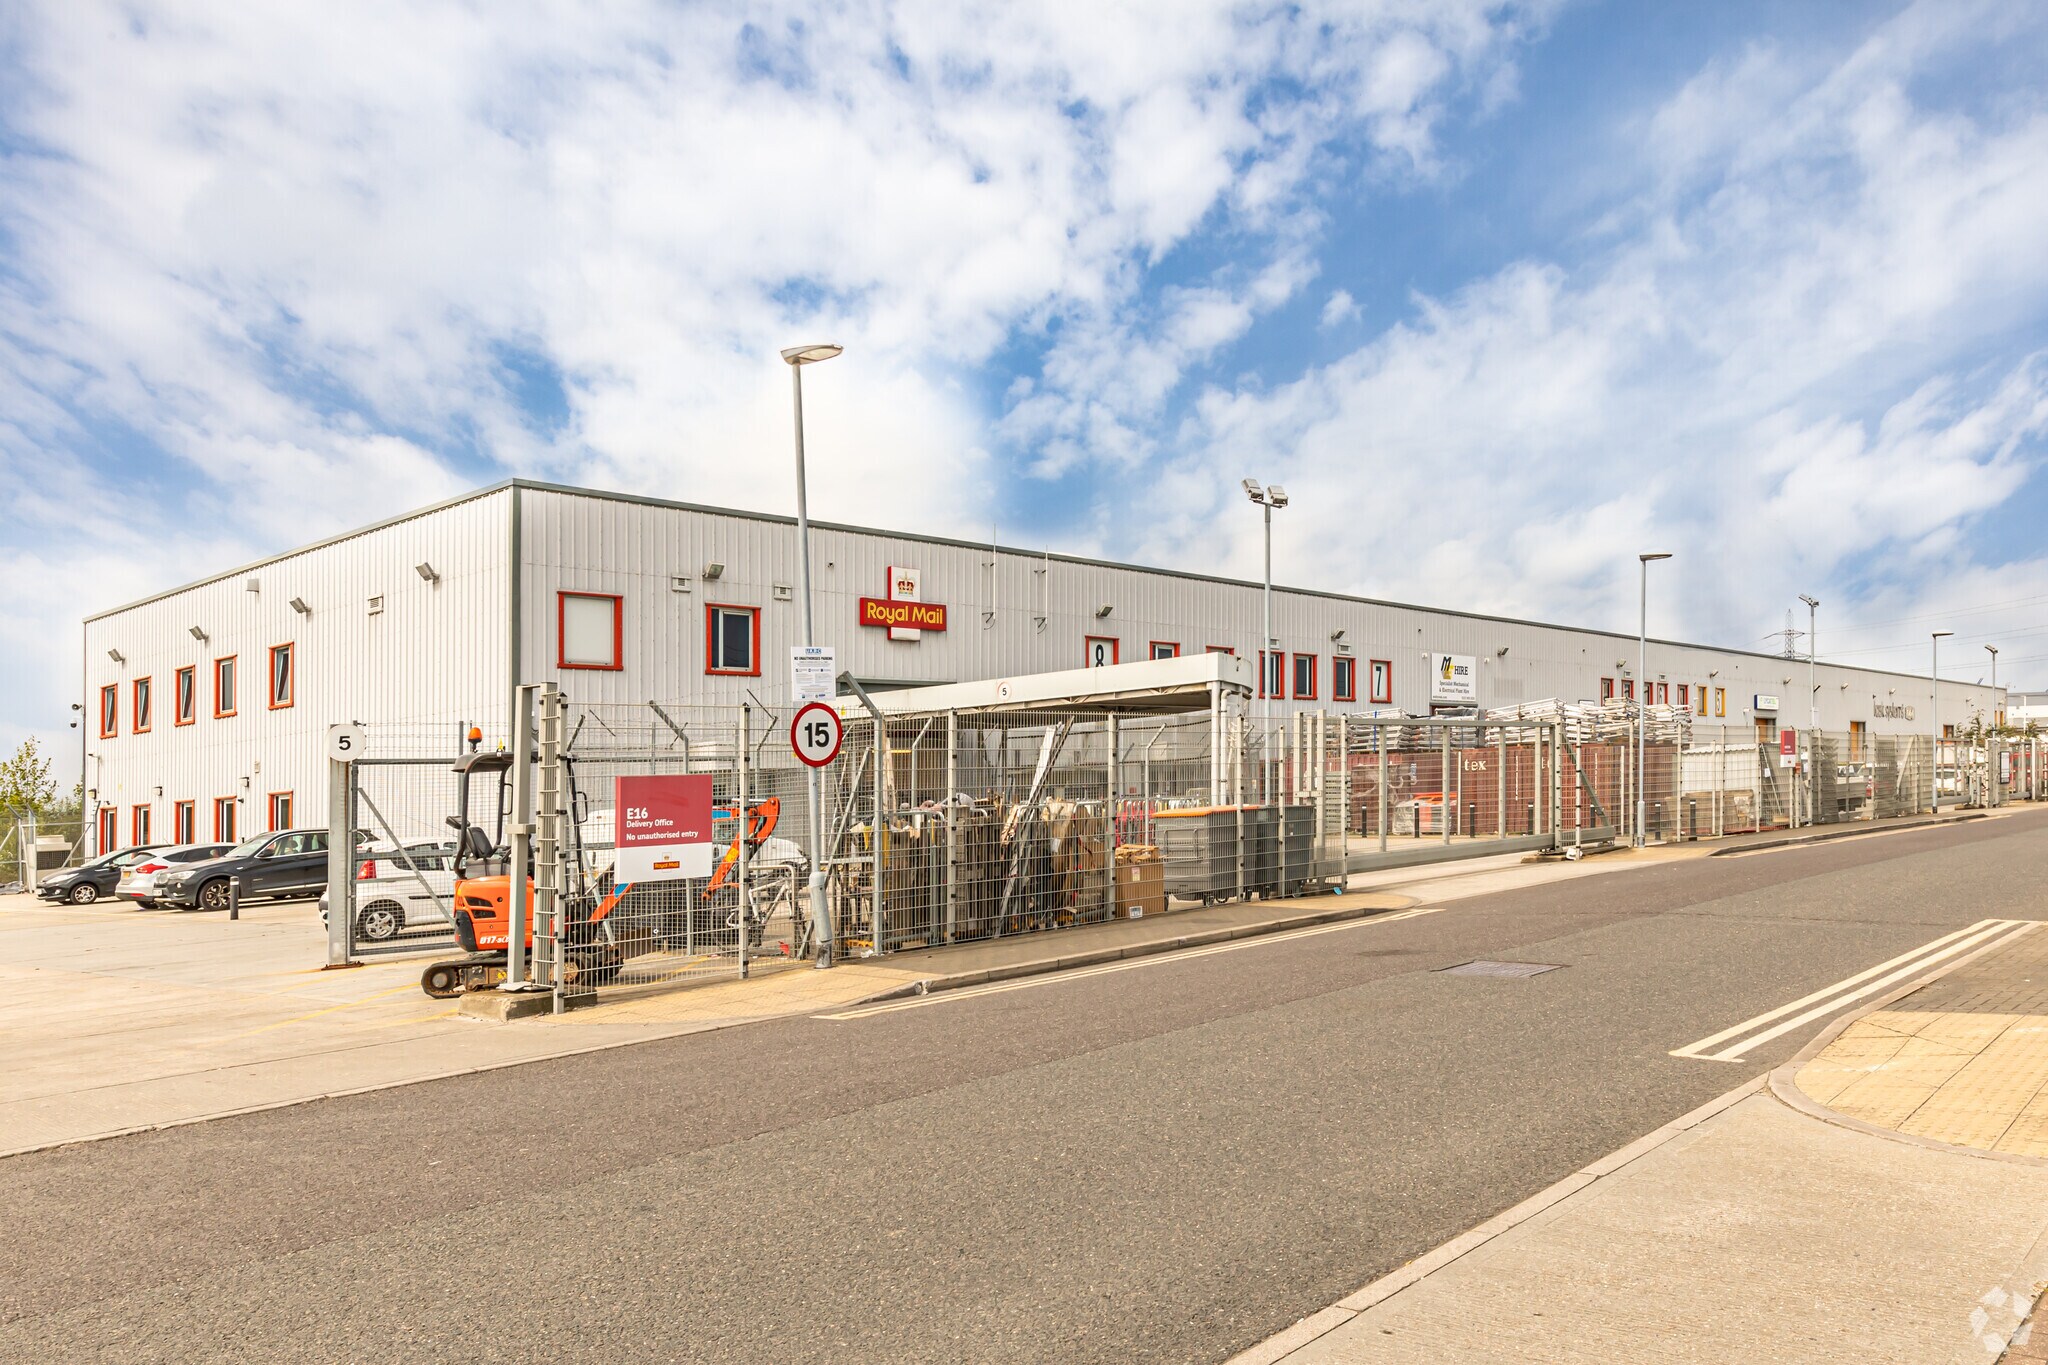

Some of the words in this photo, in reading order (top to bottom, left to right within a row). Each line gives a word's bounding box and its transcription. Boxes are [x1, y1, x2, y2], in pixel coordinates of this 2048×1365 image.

[867, 602, 909, 624] Royal
[912, 606, 943, 624] Mail
[1454, 665, 1469, 675] HIRE
[1375, 665, 1382, 696] 7
[1002, 687, 1007, 696] 5
[804, 722, 830, 748] 15
[338, 735, 351, 751] 5
[1463, 758, 1487, 771] tex
[626, 807, 649, 820] E16
[626, 819, 654, 829] Delivery
[654, 819, 674, 827] Office
[626, 833, 636, 841] No
[637, 831, 680, 840] unauthorised
[681, 830, 699, 839] entry
